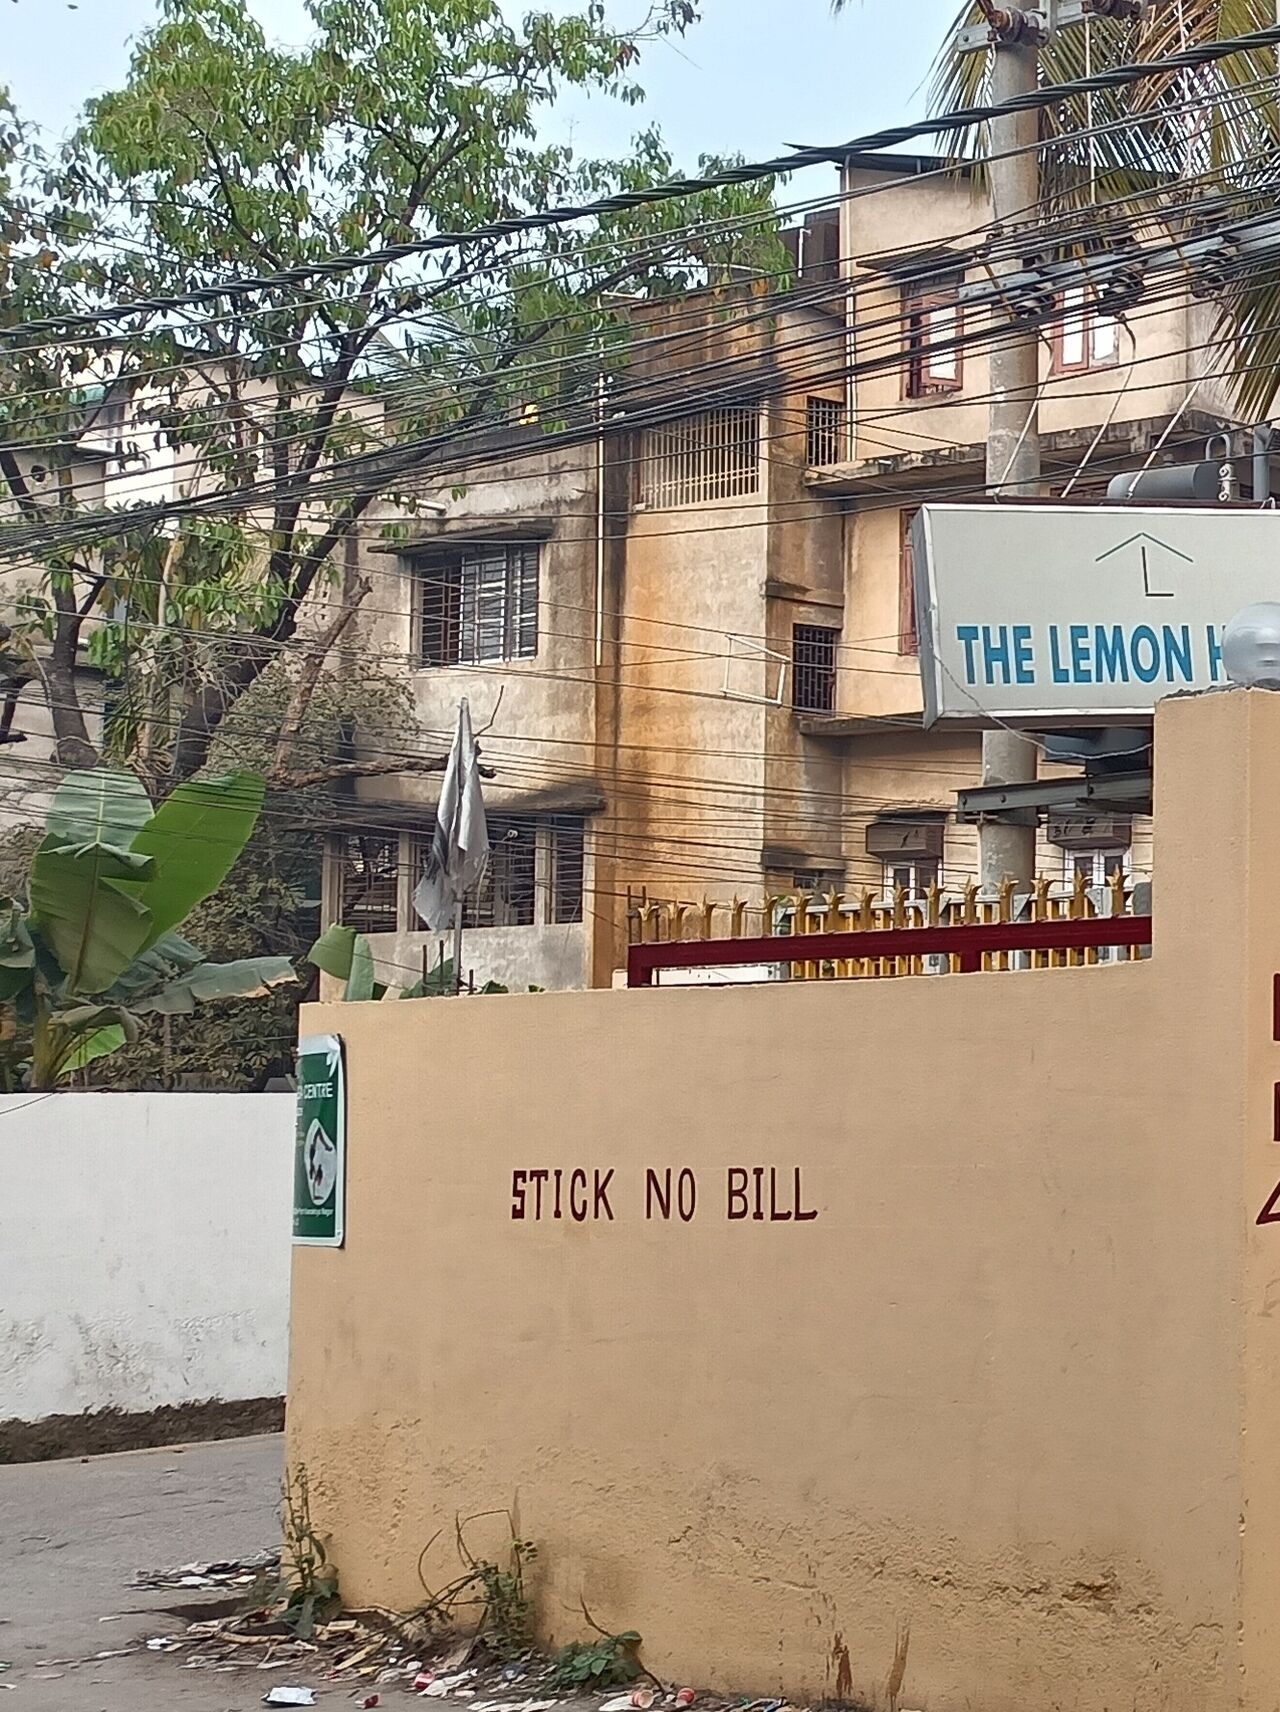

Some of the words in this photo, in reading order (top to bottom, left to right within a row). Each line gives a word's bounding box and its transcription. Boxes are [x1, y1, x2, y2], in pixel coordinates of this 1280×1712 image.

[956, 625, 1035, 685] THE
[1049, 624, 1194, 684] LEMON
[303, 1082, 334, 1100] CENTRE
[511, 1168, 615, 1222] STICK
[645, 1167, 697, 1222] NO
[727, 1166, 819, 1222] BILL
